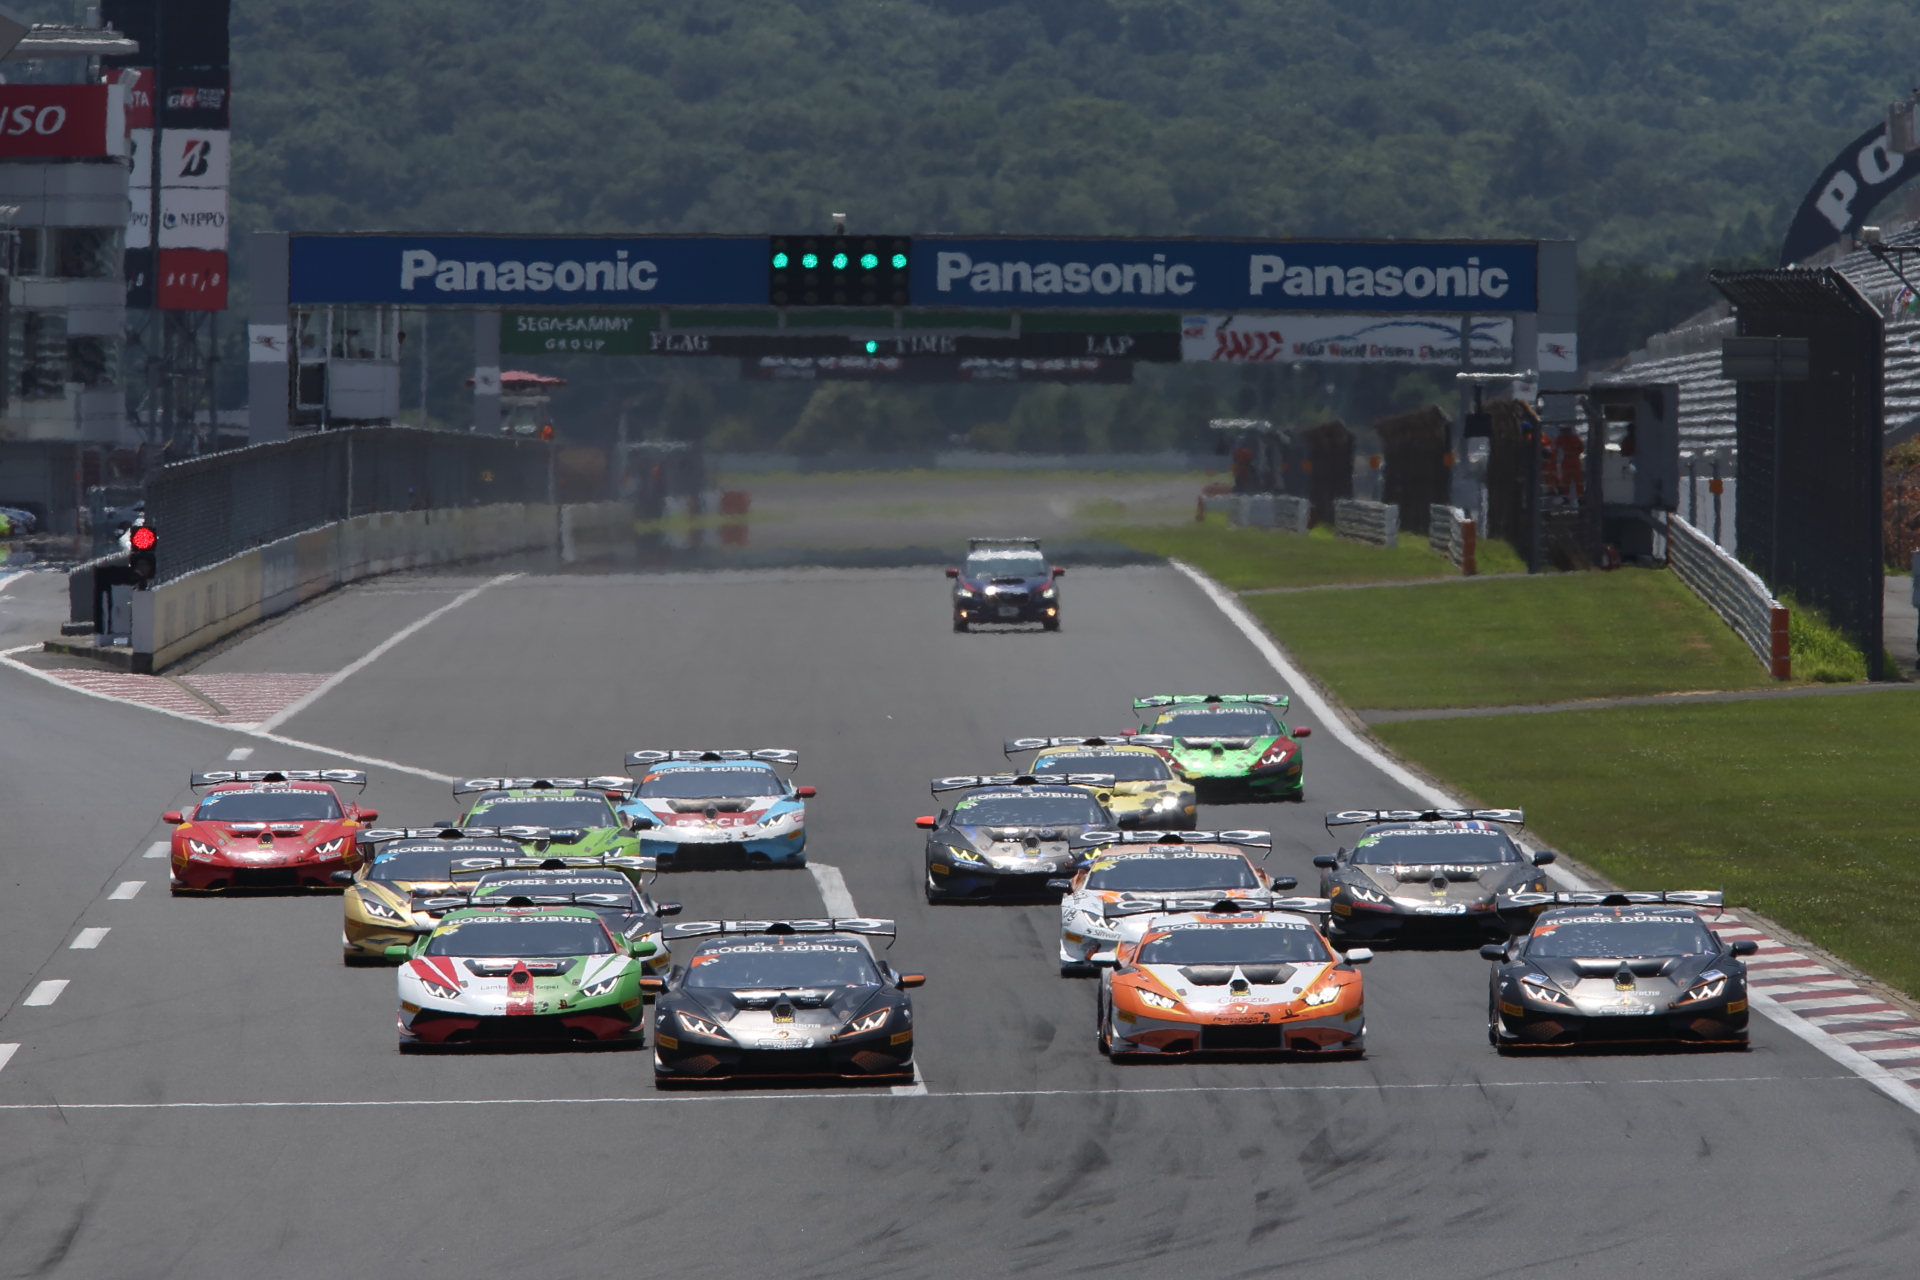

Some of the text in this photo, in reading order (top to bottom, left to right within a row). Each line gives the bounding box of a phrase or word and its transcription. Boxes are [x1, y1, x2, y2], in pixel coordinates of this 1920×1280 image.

[0, 105, 66, 136] SO
[400, 247, 660, 294] Panasonic
[937, 250, 1195, 296] Panasonic
[1249, 253, 1509, 299] Panasonic
[653, 766, 766, 775] ROGER DUBUIS
[211, 788, 328, 797] ROGER DUBUIS
[966, 792, 1088, 802] ROGER DUBUIS
[482, 795, 602, 805] ROGER DUBUIS
[1369, 828, 1499, 838] ROGER DUBUIS
[387, 845, 516, 854] ROGER DUBUIS
[1105, 852, 1238, 861] ROGER DUBUIS
[485, 878, 624, 888] ROGER DUBUIS
[447, 915, 593, 926] ROGER DUBUIS
[1545, 915, 1695, 926] ROGER DUBUIS
[1157, 922, 1307, 933] ROGER DUBUIS
[704, 944, 859, 956] ROGER DUBUIS
